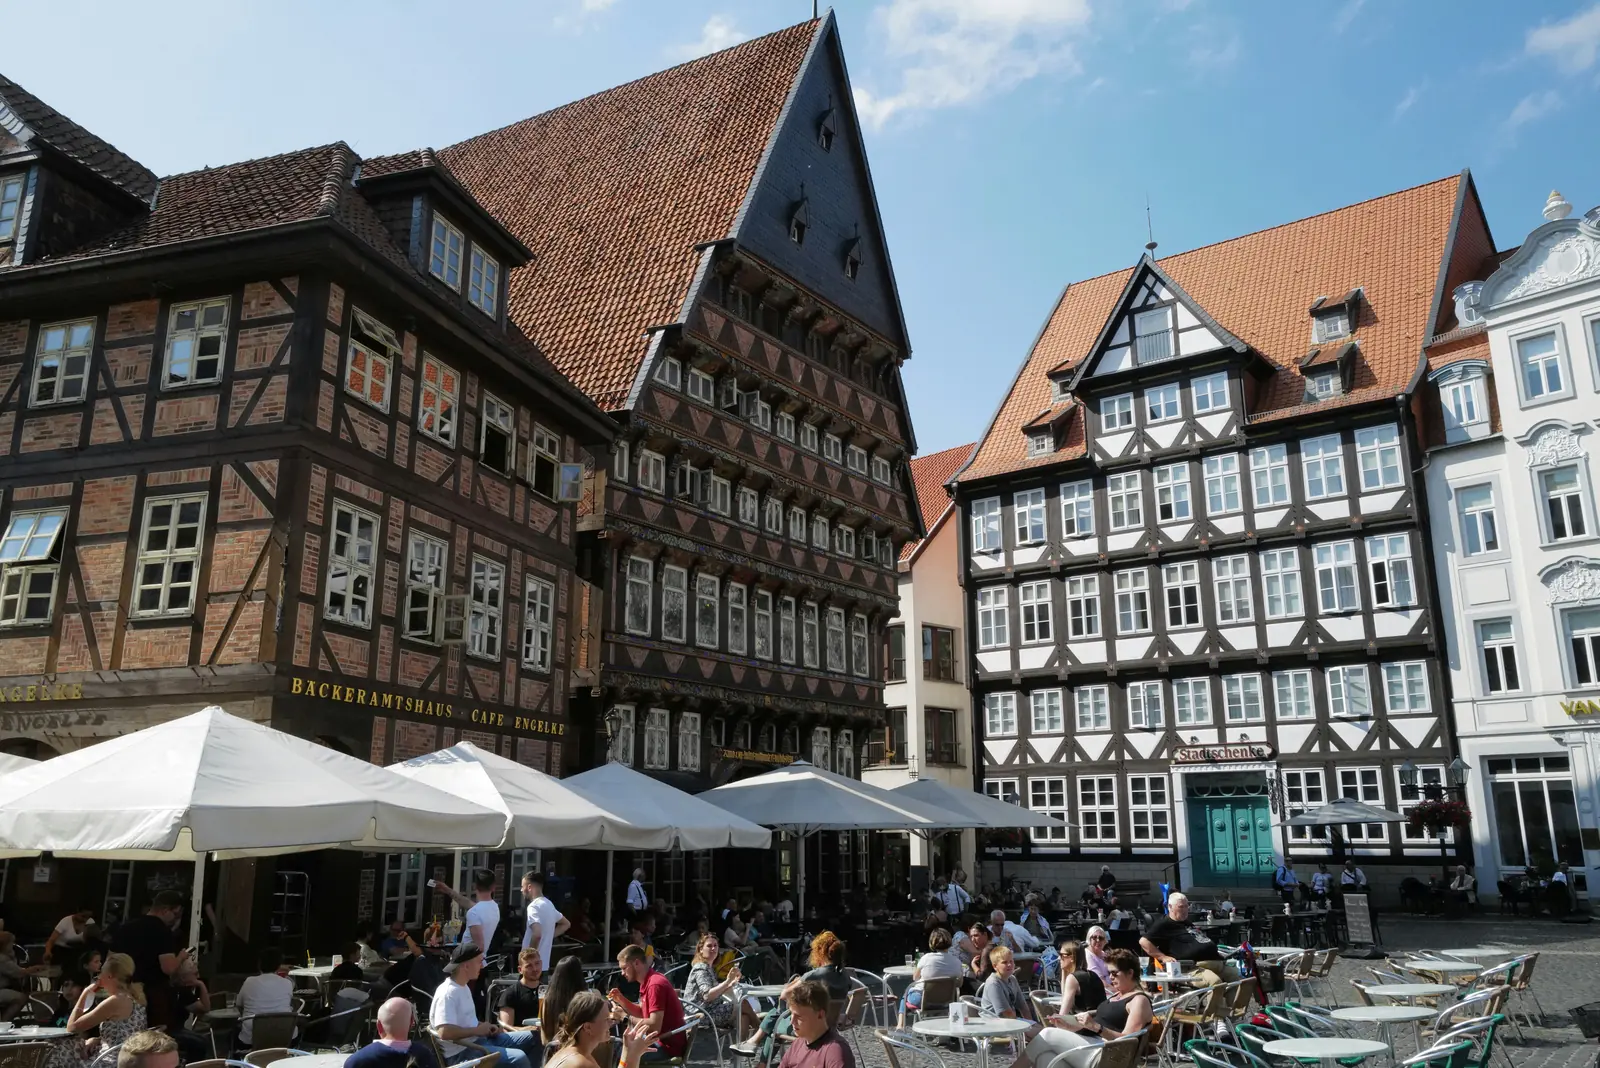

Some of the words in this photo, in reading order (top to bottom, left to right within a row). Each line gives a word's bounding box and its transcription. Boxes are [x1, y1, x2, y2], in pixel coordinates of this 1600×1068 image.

[291, 677, 453, 718] BÄCKERAMTSHAUS
[471, 709, 504, 727] CAFE
[514, 716, 565, 736] ENGELKE
[1179, 745, 1265, 761] Stadtschenke
